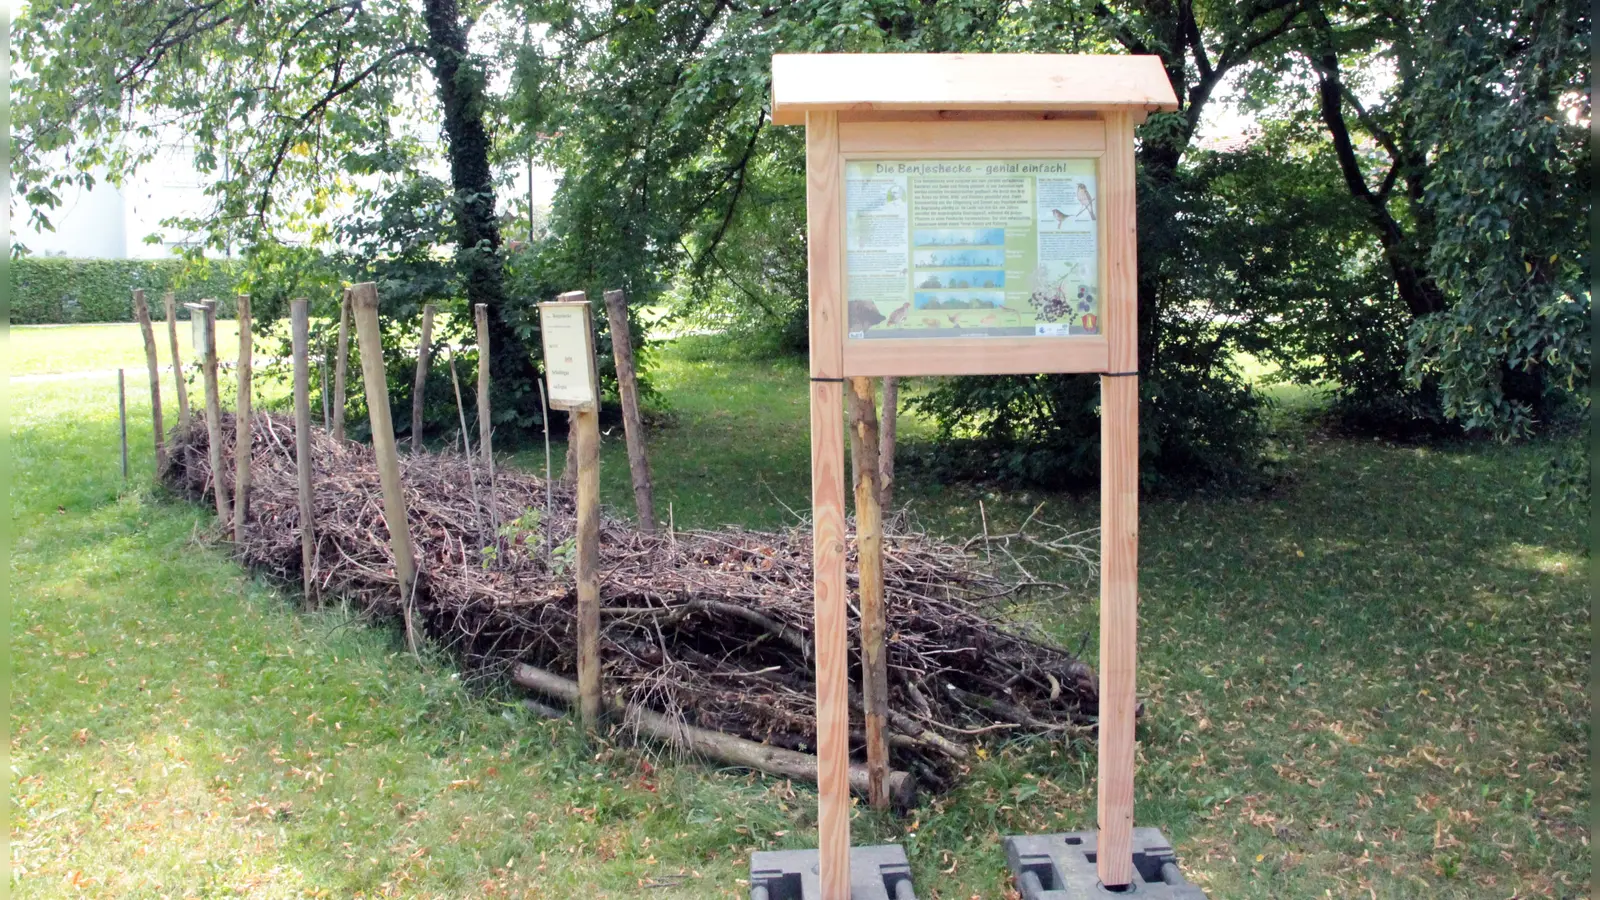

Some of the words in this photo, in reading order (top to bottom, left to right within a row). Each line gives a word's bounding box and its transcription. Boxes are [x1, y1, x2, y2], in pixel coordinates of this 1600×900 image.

[876, 163, 895, 174] Die
[898, 163, 972, 176] Benjeshecke
[986, 163, 1018, 175] genial
[1022, 163, 1067, 173] einfach!
